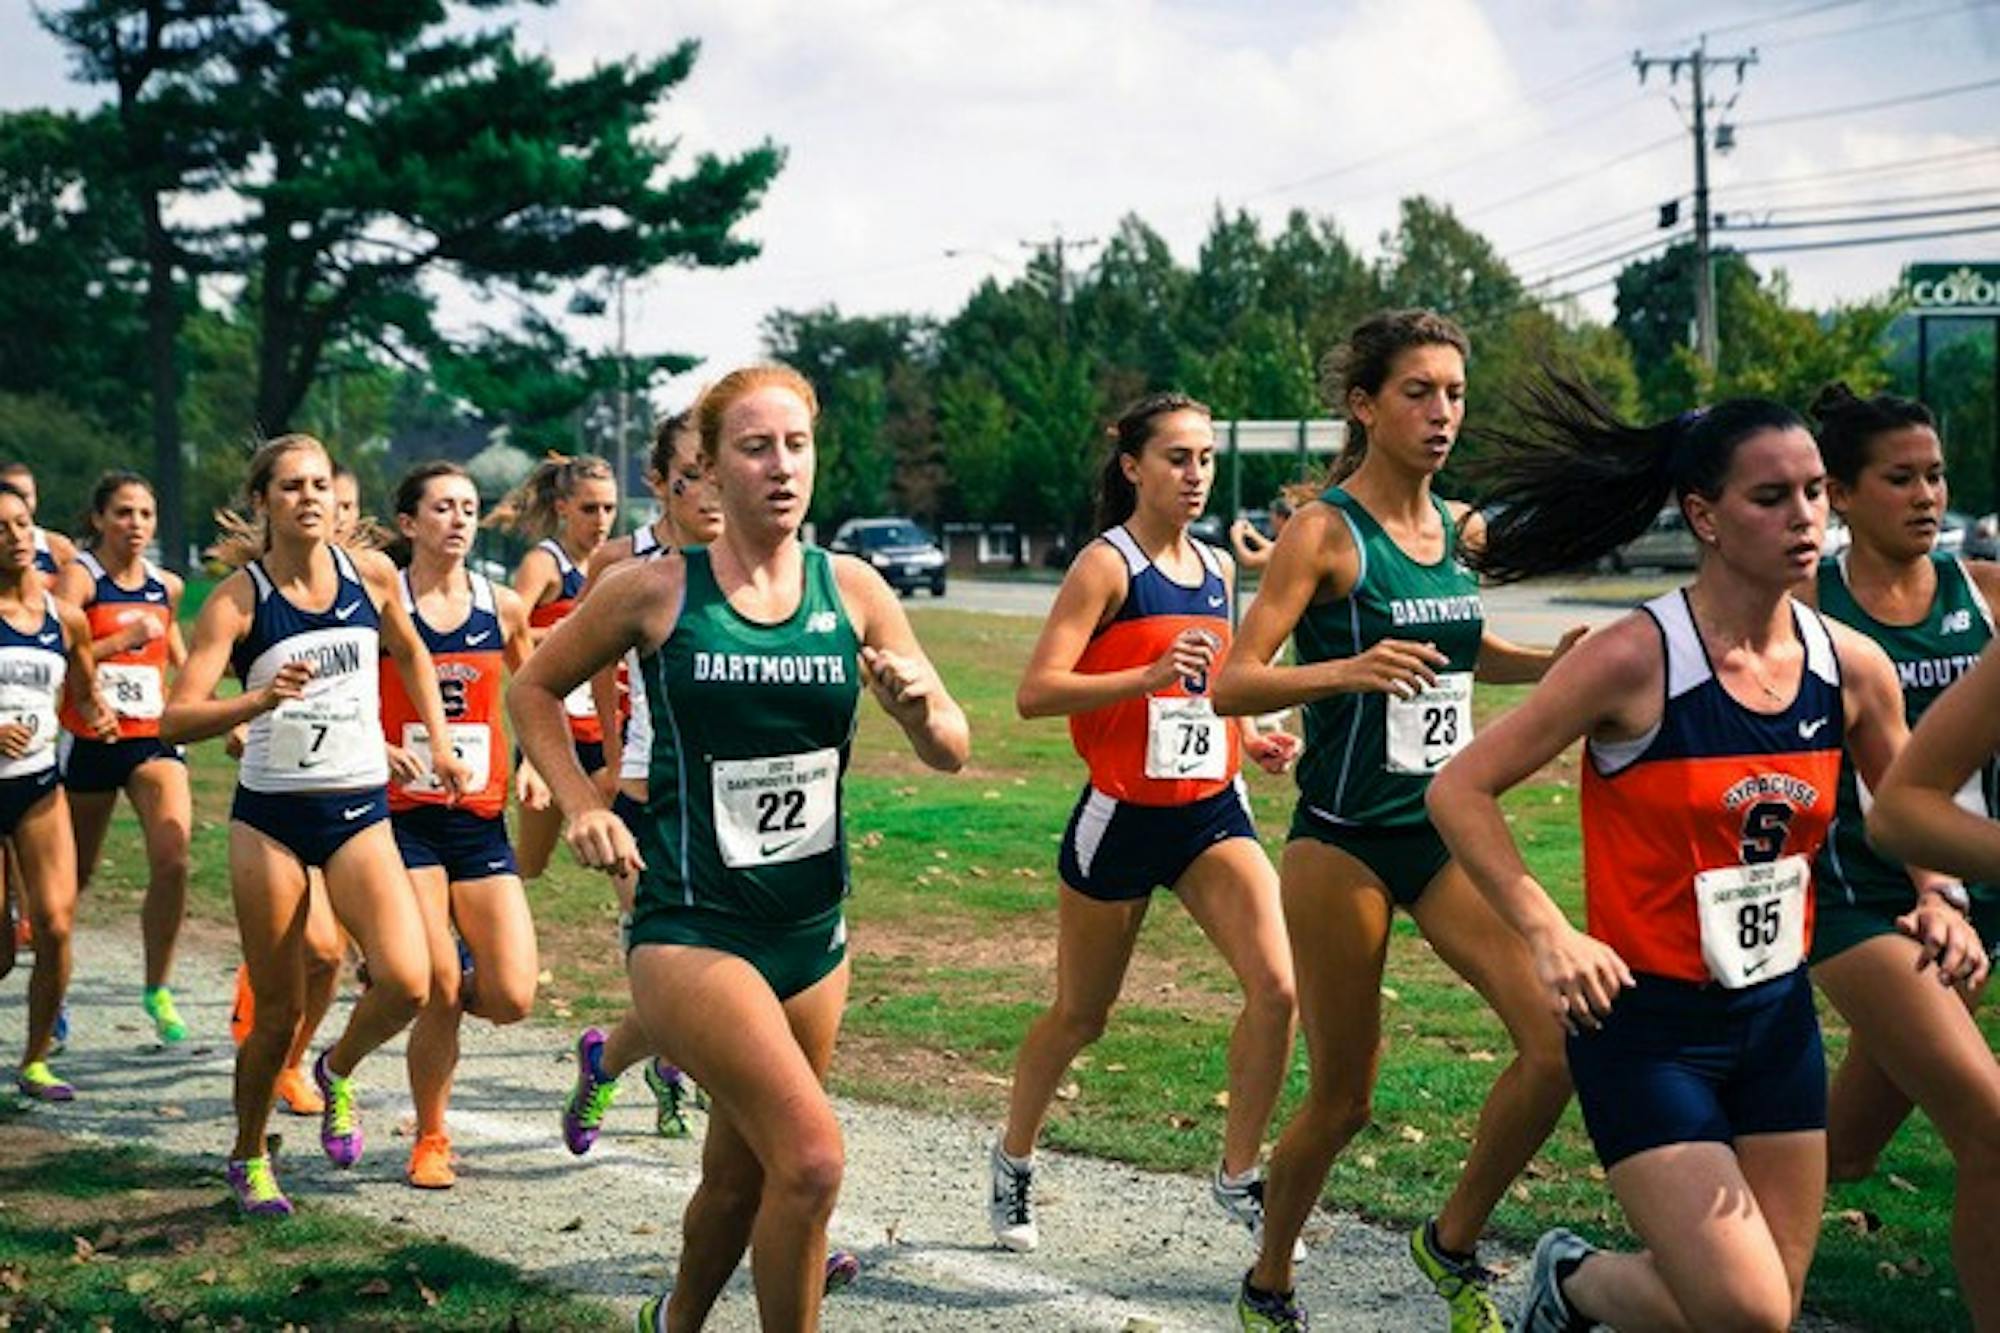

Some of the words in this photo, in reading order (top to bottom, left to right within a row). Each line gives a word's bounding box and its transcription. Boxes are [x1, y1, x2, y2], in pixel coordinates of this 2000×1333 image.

[693, 652, 846, 684] DARTMOUTH
[311, 724, 328, 752] 7
[1177, 722, 1209, 755] 78
[1423, 707, 1458, 745] 23
[1722, 773, 1818, 811] SYRACUSE
[757, 789, 806, 834] 22
[1741, 800, 1796, 865] S
[1738, 898, 1780, 948] 85
